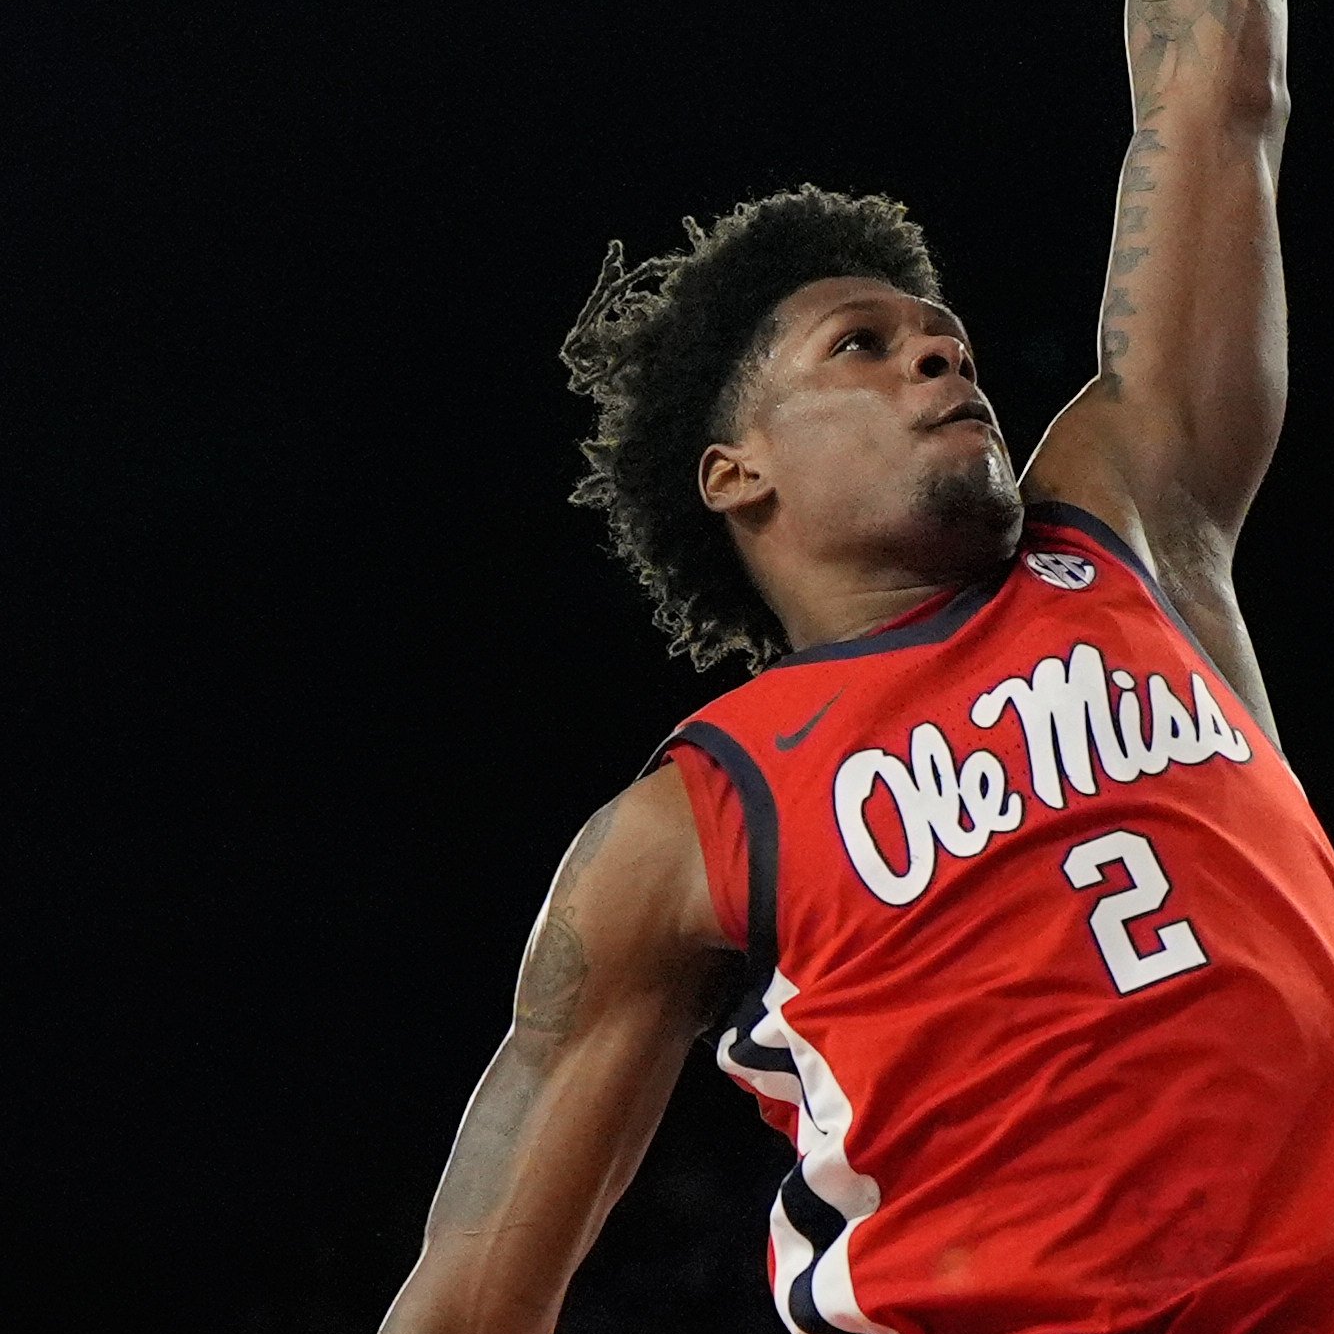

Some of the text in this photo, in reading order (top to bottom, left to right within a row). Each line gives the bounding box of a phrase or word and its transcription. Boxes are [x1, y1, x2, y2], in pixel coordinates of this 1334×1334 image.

[833, 642, 1253, 907] Ole Miss
[1061, 829, 1210, 996] 2
